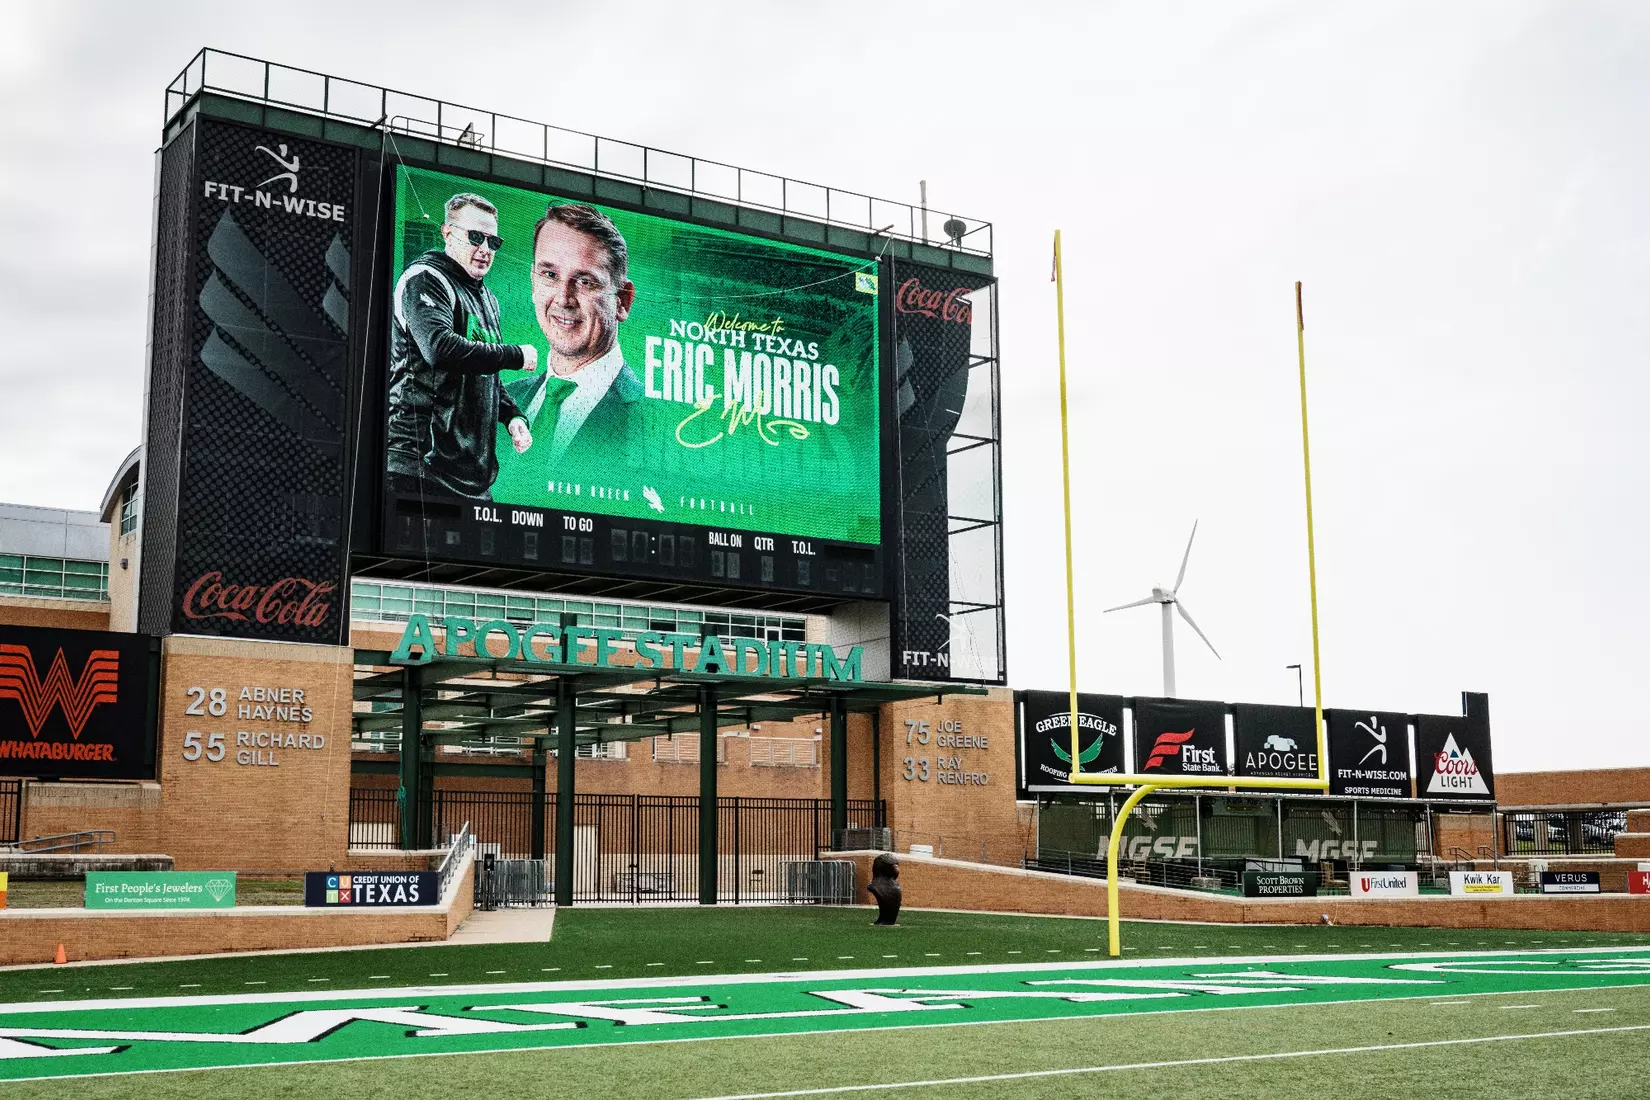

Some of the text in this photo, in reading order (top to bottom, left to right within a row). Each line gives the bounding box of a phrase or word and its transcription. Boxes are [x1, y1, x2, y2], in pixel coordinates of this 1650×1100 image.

[204, 180, 345, 222] FIT-N-WISE
[704, 310, 785, 336] Welcome to
[670, 318, 818, 360] NORTH TEXAS
[645, 335, 840, 425] ERIC MORRIS
[548, 481, 753, 515] MEAN GREEN FOOTBALL
[474, 506, 502, 523] T.O.L.
[512, 510, 544, 527] DOWN
[563, 516, 593, 532] TO GO
[709, 532, 742, 548] BALL ON
[754, 536, 774, 551] QTR
[792, 541, 816, 556] T.O.L.
[390, 614, 864, 682] APOGEE STADIUM
[185, 686, 228, 717] 28
[239, 686, 305, 704] ABNER
[238, 705, 313, 722] HAYNES
[904, 720, 930, 744] 75
[937, 720, 961, 733] JOE
[1079, 716, 1117, 736] EAGLE
[183, 731, 226, 762] 55
[236, 731, 325, 750] RICHARD
[937, 735, 988, 749] GREENE
[0, 740, 115, 761] WHATABURGER
[237, 750, 279, 766] GILL
[1182, 744, 1215, 763] First
[903, 757, 931, 781] 33
[937, 757, 962, 770] RAY
[1183, 762, 1201, 772] State
[1246, 752, 1318, 771] APOGEE
[1434, 751, 1477, 775] Coors
[937, 772, 988, 786] RENFRO
[1040, 764, 1067, 778] ROOFING
[1338, 769, 1407, 780] FIT-N-WISE.COM
[1441, 776, 1472, 788] LIGHT
[1344, 787, 1402, 795] SPORTS MEDICINE
[353, 876, 420, 884] CREDIT UNION OF
[1464, 874, 1501, 884] Kwik Kar
[1555, 873, 1588, 882] VERUS
[95, 883, 203, 895] First People's Jewelers
[353, 884, 419, 903] TEXAS
[1259, 885, 1303, 893] PROPERTIES
